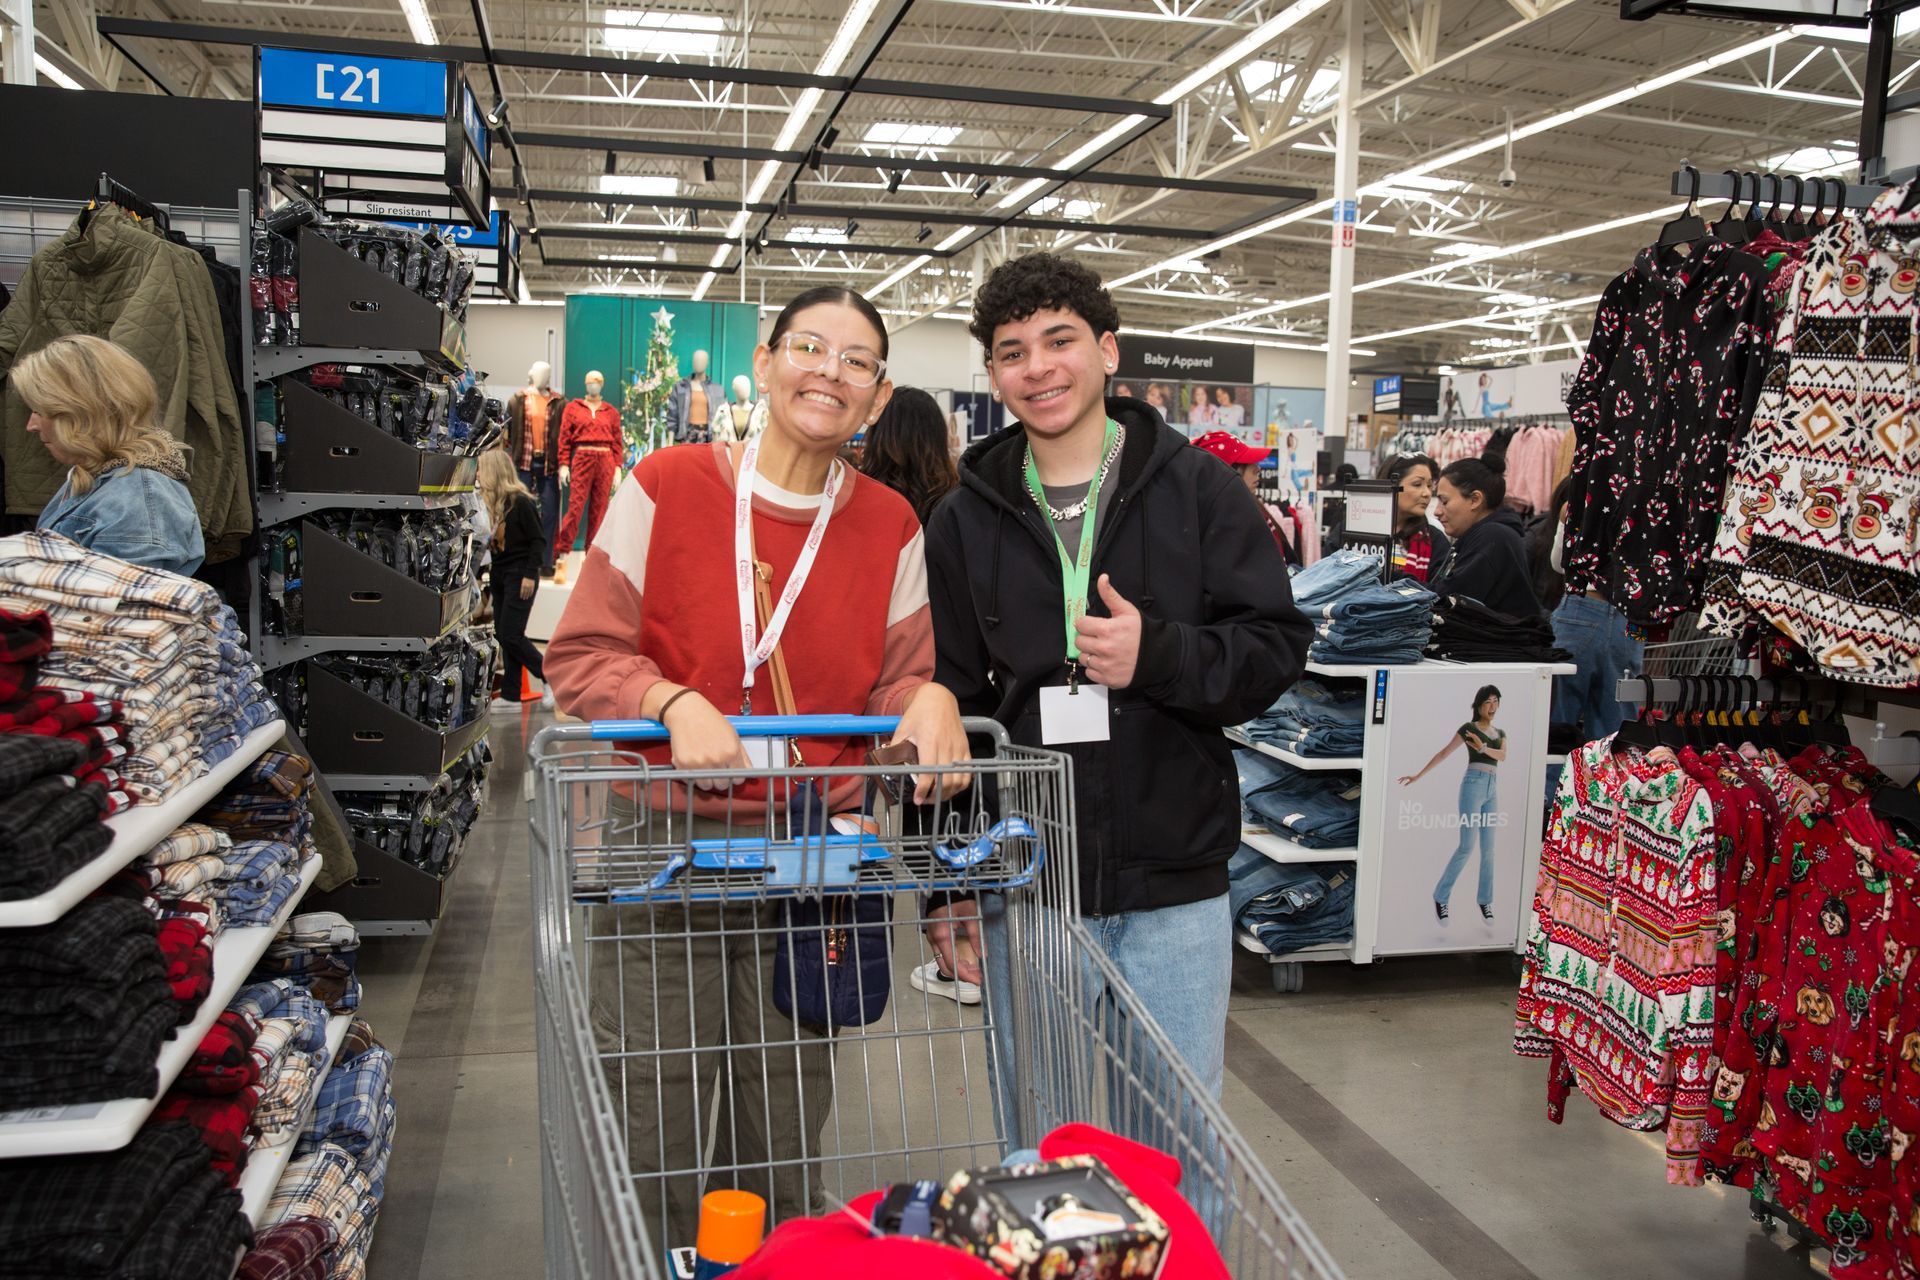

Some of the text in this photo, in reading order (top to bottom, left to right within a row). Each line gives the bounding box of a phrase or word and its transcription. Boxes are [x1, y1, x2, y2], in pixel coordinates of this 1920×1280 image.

[366, 203, 432, 218] Slip resistant
[1143, 352, 1214, 370] Baby Apparel
